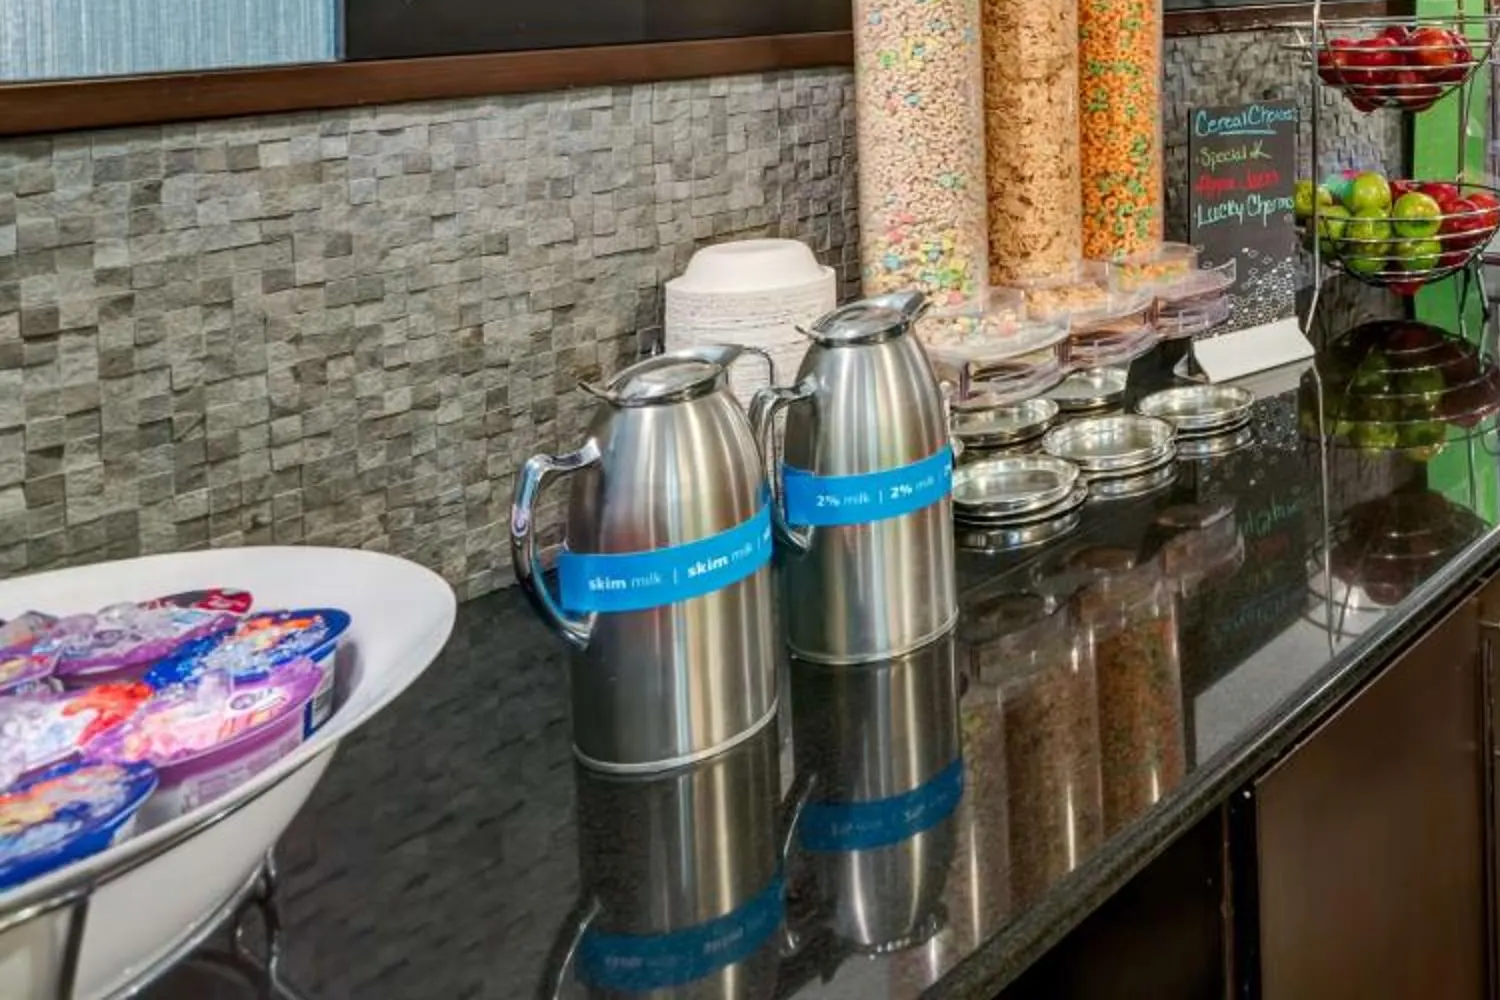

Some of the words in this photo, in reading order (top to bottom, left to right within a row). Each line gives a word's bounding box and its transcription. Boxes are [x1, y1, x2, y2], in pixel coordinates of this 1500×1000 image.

[1195, 109, 1247, 136] Cereal
[1197, 199, 1245, 228] Lucky
[890, 484, 914, 500] 2%
[688, 553, 729, 579] skim
[588, 576, 628, 592] skim
[631, 572, 662, 589] milk
